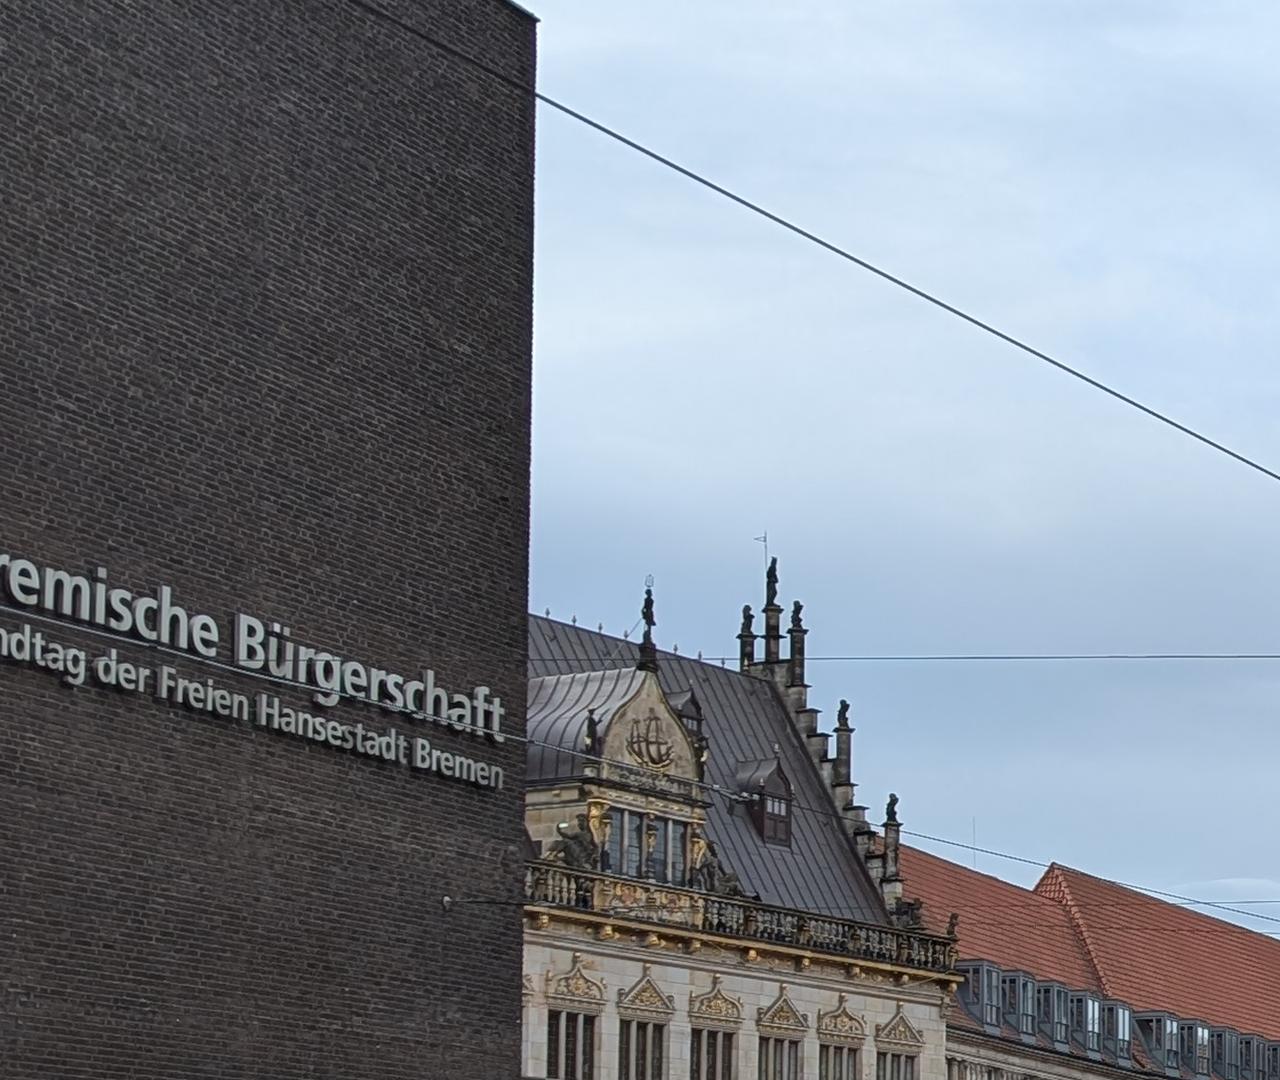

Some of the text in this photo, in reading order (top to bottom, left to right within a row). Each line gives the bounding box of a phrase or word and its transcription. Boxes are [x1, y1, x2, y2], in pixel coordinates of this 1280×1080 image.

[98, 649, 151, 692] der
[160, 665, 250, 721] Freien
[259, 692, 409, 765] Hansestadt
[412, 741, 504, 790] Bremen
[235, 612, 505, 742] Bürgerschaft
